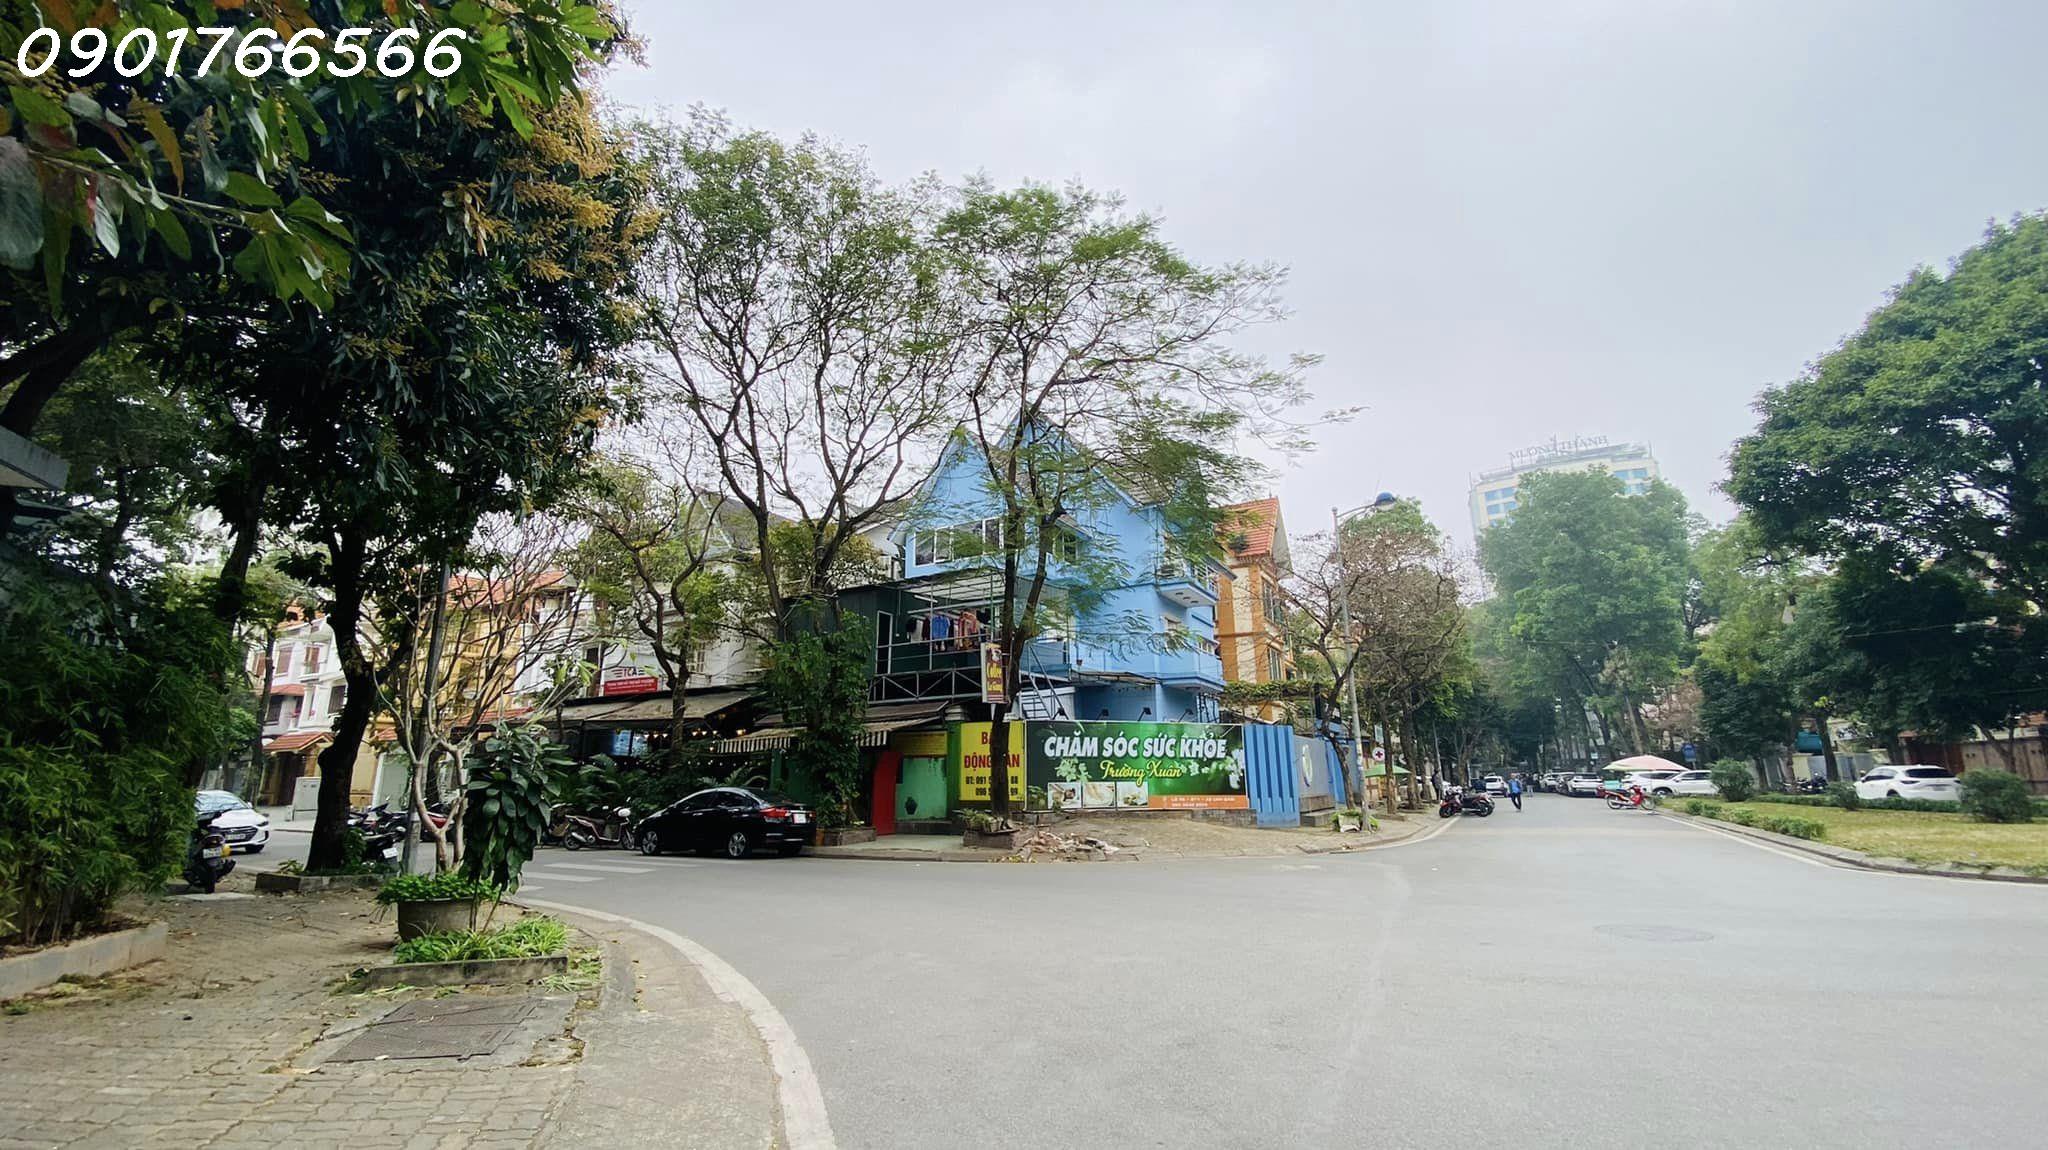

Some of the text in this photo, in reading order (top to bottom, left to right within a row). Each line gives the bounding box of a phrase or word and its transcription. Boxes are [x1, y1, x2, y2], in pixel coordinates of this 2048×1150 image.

[1043, 731, 1227, 759] CHĂM SÓC SỨC KHỎE
[964, 752, 992, 771] ĐỘNG
[1100, 760, 1183, 786] Trường Xuân
